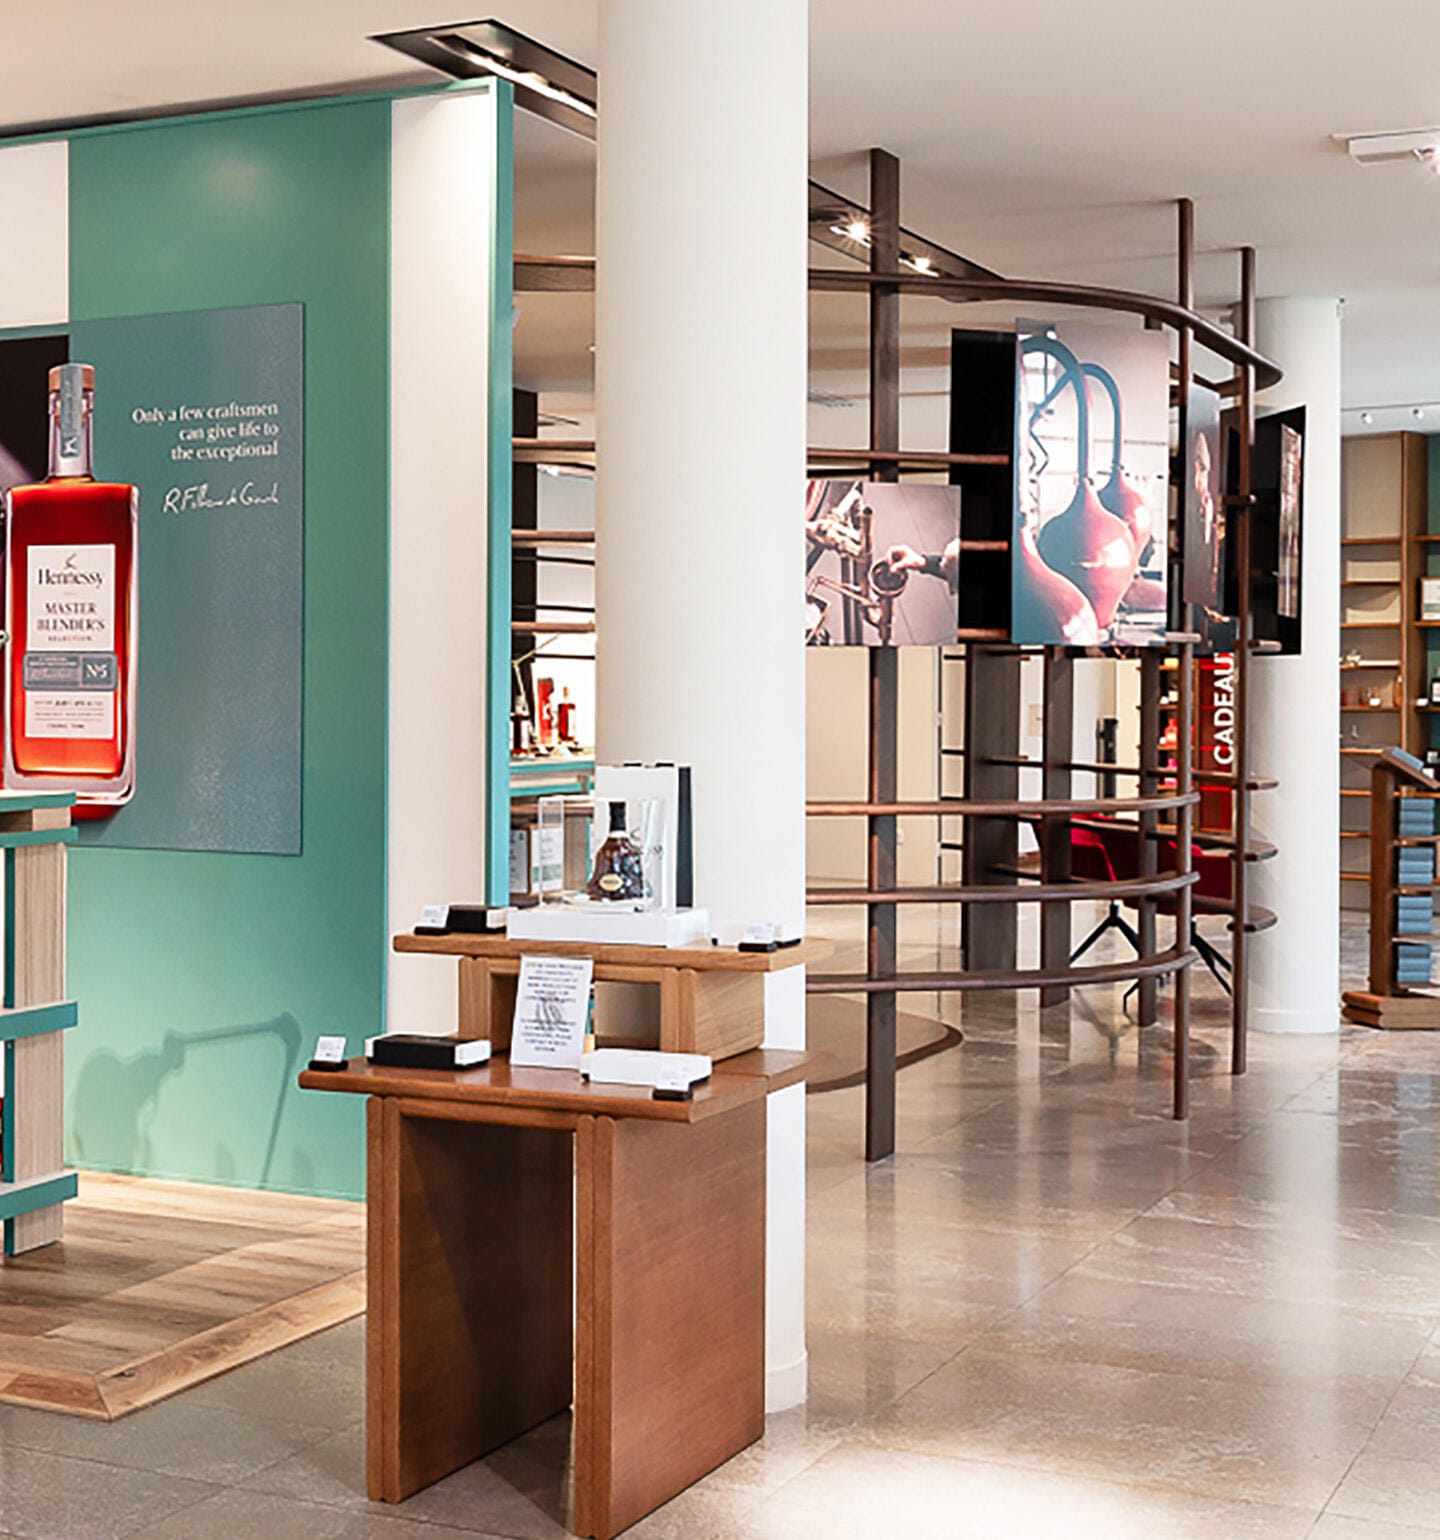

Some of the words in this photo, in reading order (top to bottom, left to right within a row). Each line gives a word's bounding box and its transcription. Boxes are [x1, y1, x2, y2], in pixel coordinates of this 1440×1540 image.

[132, 407, 165, 426] Only
[167, 410, 177, 421] a
[179, 405, 204, 420] few
[206, 401, 278, 419] craftsmen
[179, 428, 205, 440] can
[206, 424, 237, 443] give
[239, 421, 261, 437] life
[263, 422, 279, 436] to
[171, 446, 194, 461] the
[196, 441, 278, 462] exceptional
[38, 568, 103, 590] Hennessy
[45, 602, 97, 614] MASTER
